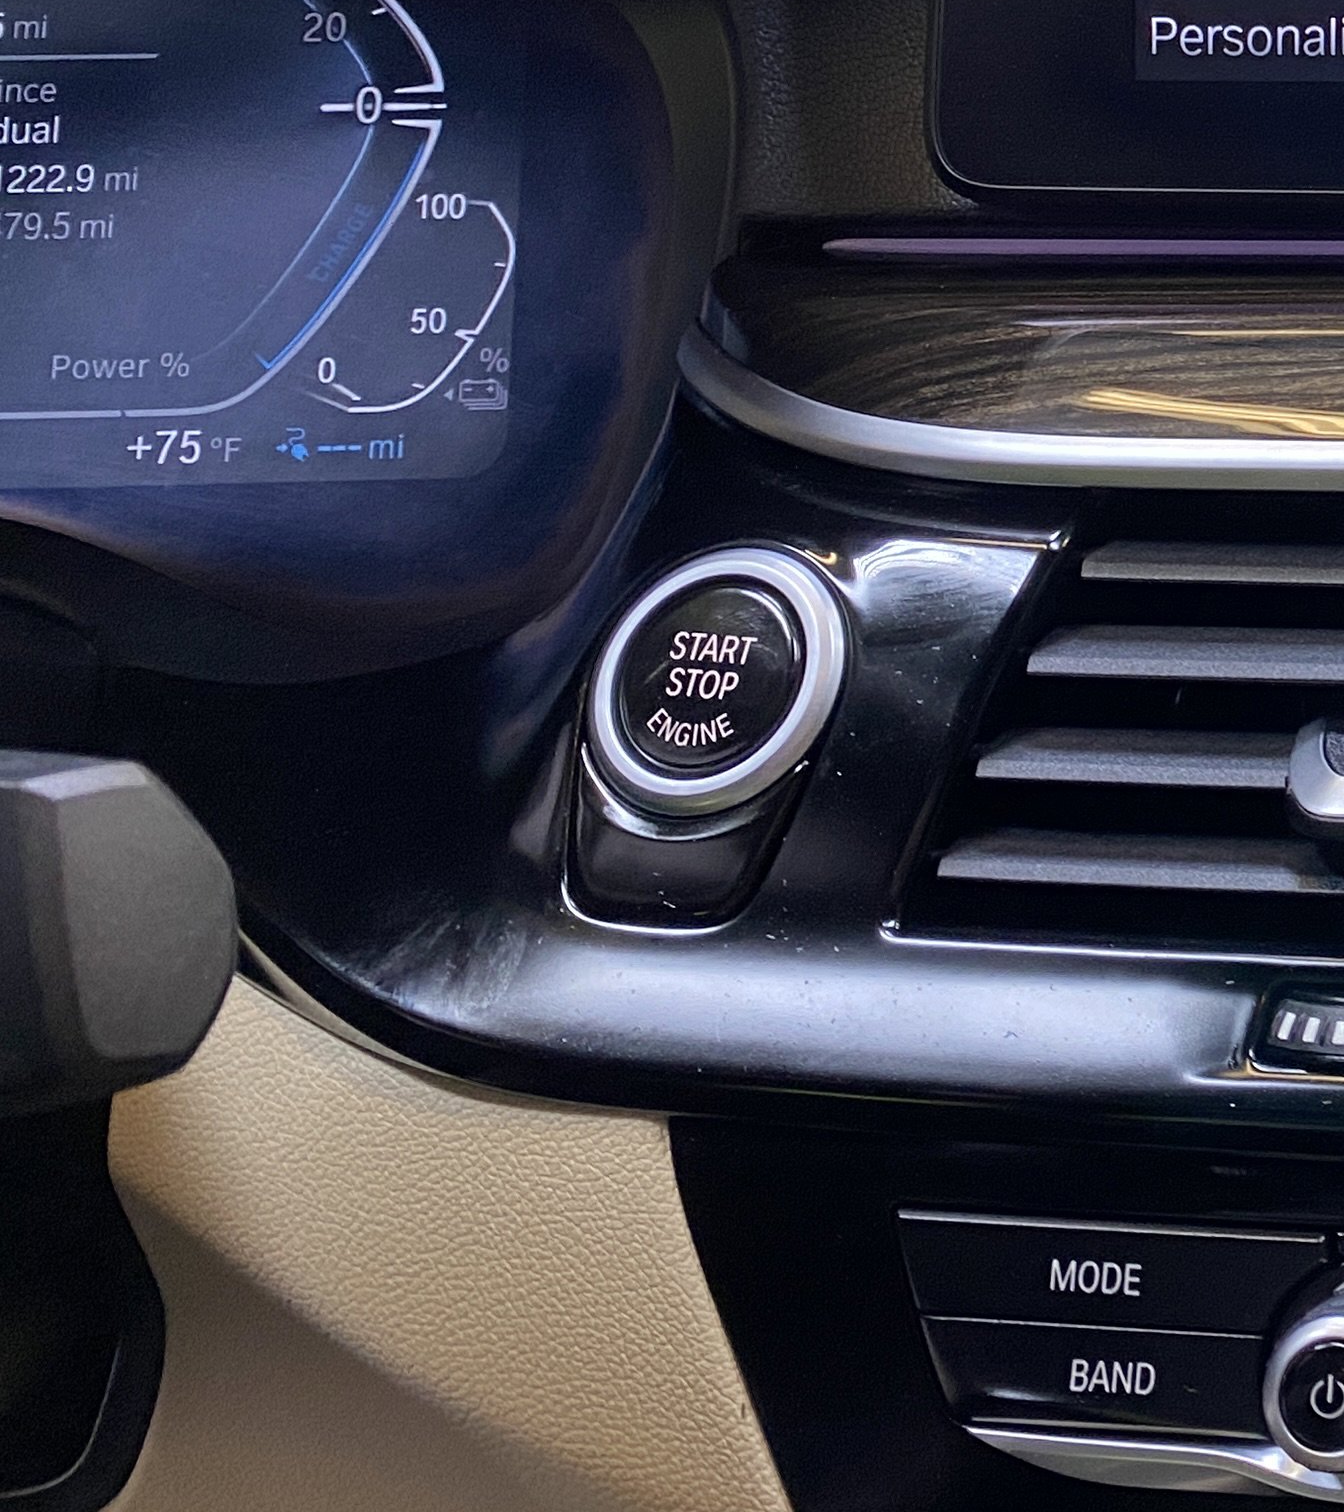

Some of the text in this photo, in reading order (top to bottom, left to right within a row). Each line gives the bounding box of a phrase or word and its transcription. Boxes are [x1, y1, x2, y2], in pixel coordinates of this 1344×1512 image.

[13, 14, 48, 40] mi
[303, 11, 346, 42] 20
[355, 86, 384, 124] 0
[104, 166, 138, 192] mi
[412, 192, 467, 222] 100
[79, 213, 114, 239] mi
[410, 307, 447, 334] 50
[51, 352, 190, 380] Power %
[318, 357, 336, 384] 0
[126, 429, 203, 465] +75
[368, 434, 404, 460] mi
[670, 631, 758, 665] START
[665, 667, 739, 700] STOP
[646, 707, 735, 747] ENGINE
[1049, 1258, 1142, 1297] MODE
[1069, 1358, 1156, 1396] BAND
